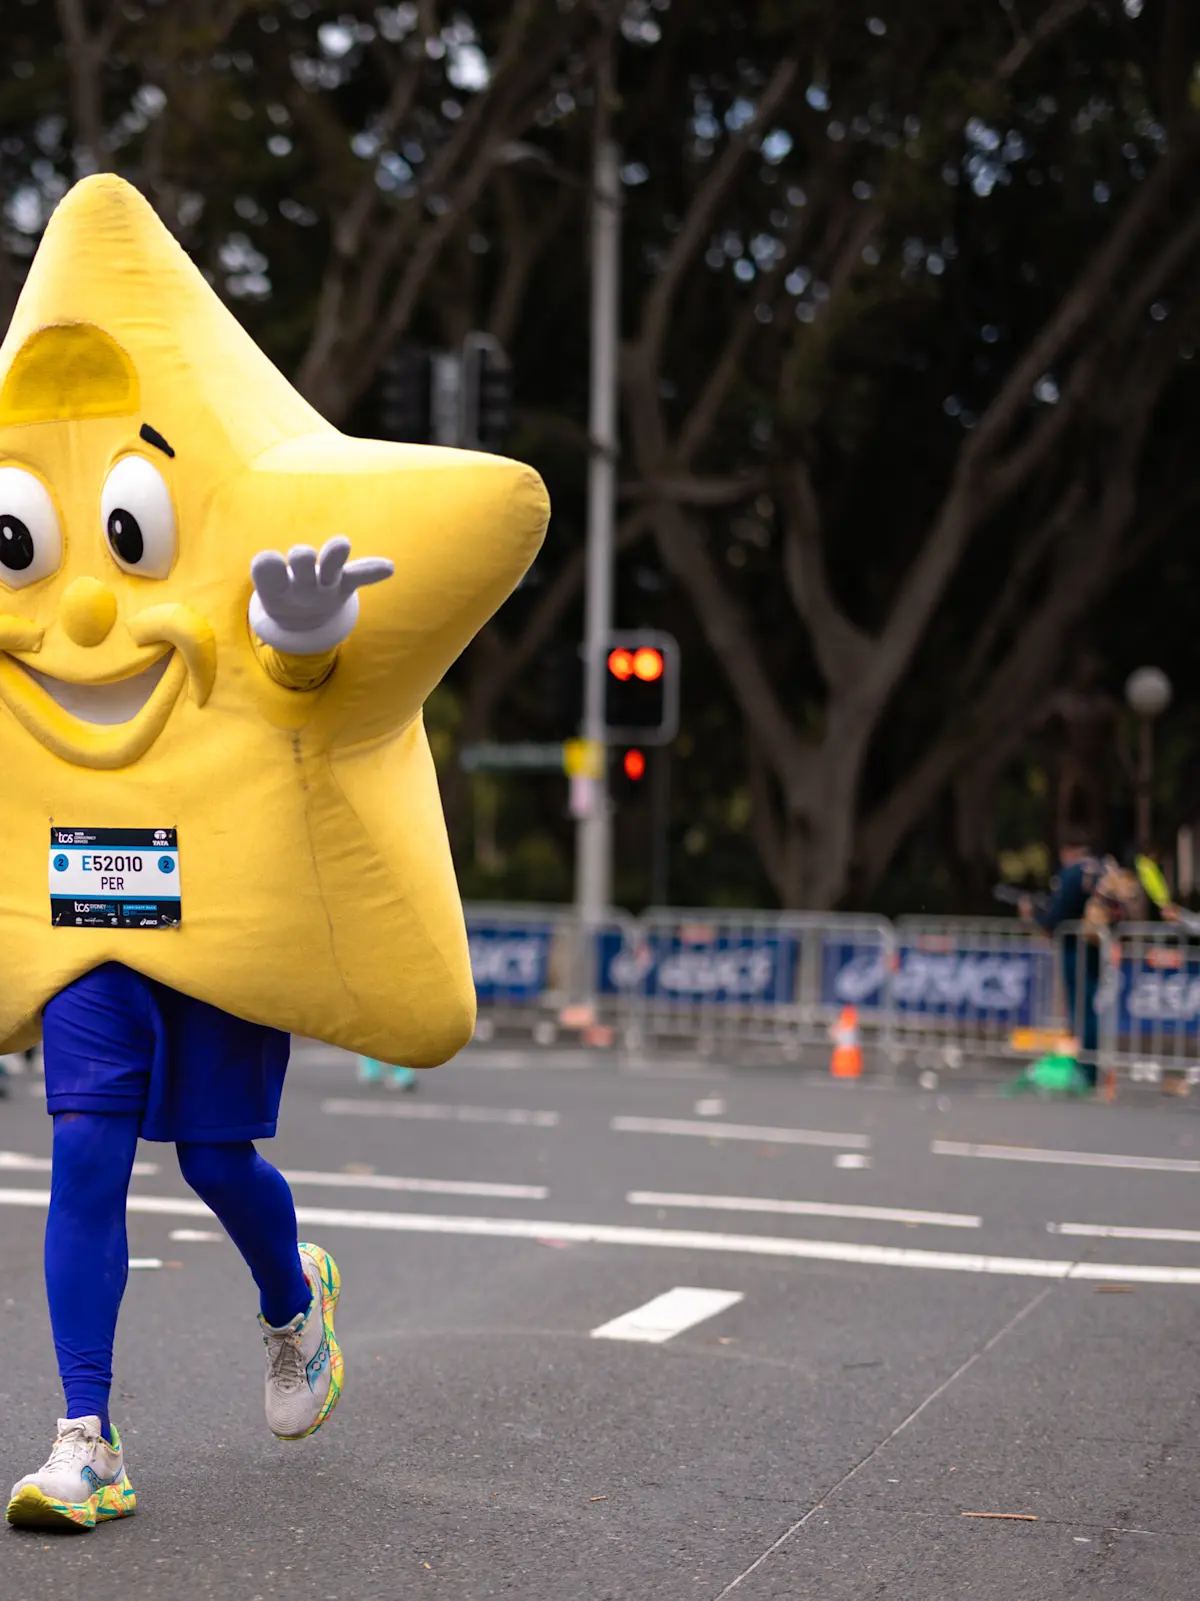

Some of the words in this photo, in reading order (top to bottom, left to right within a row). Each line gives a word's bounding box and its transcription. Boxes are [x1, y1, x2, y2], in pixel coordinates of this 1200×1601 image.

[58, 832, 73, 844] tcs
[58, 858, 64, 867] 2
[82, 855, 143, 872] E52010
[163, 860, 170, 869] 2
[101, 876, 125, 890] PER
[74, 901, 90, 913] tcs
